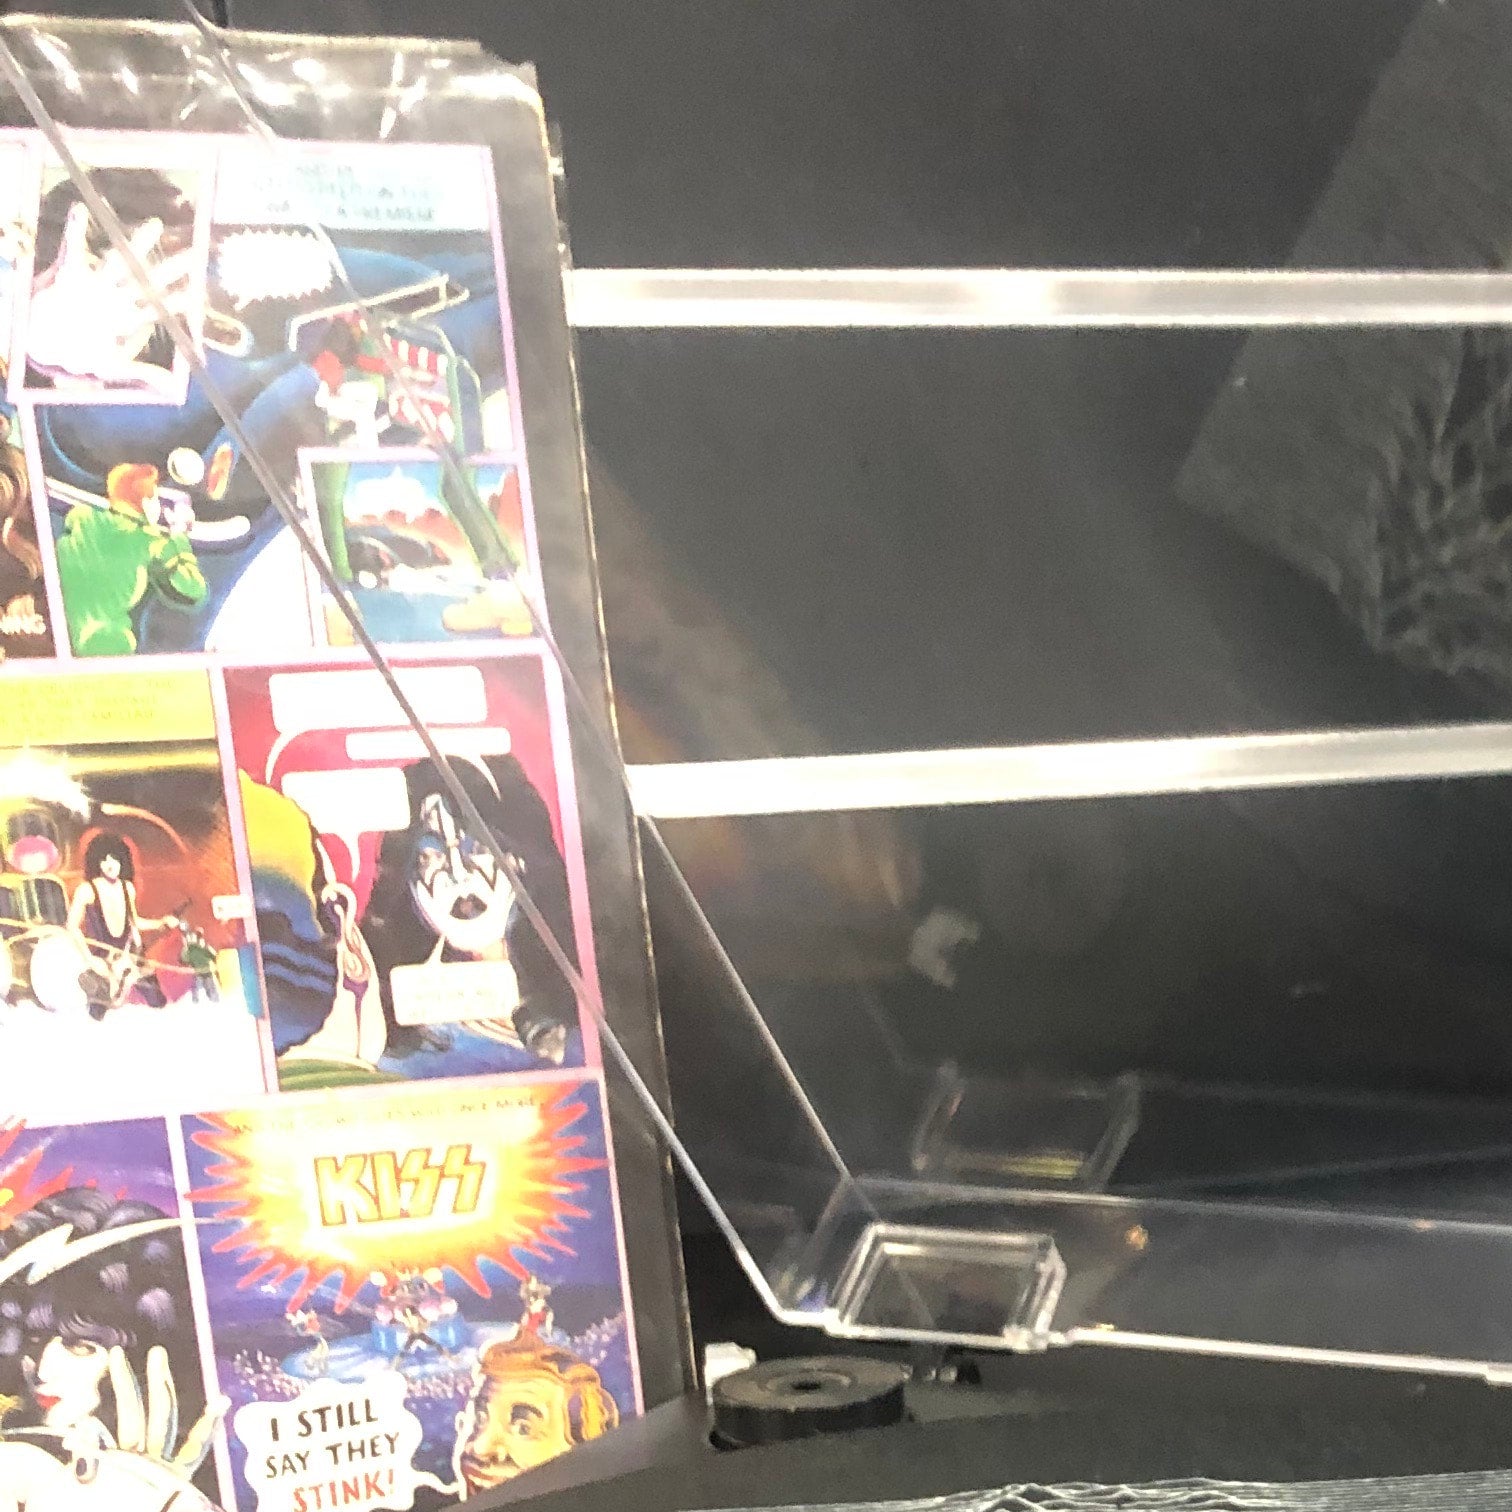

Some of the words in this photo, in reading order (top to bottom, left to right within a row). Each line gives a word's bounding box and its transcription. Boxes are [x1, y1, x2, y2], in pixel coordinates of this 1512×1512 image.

[313, 1143, 486, 1227] KISS
[270, 1417, 280, 1442] I
[297, 1398, 379, 1438] STILL
[265, 1450, 310, 1479] SAY
[325, 1432, 400, 1466] THEY
